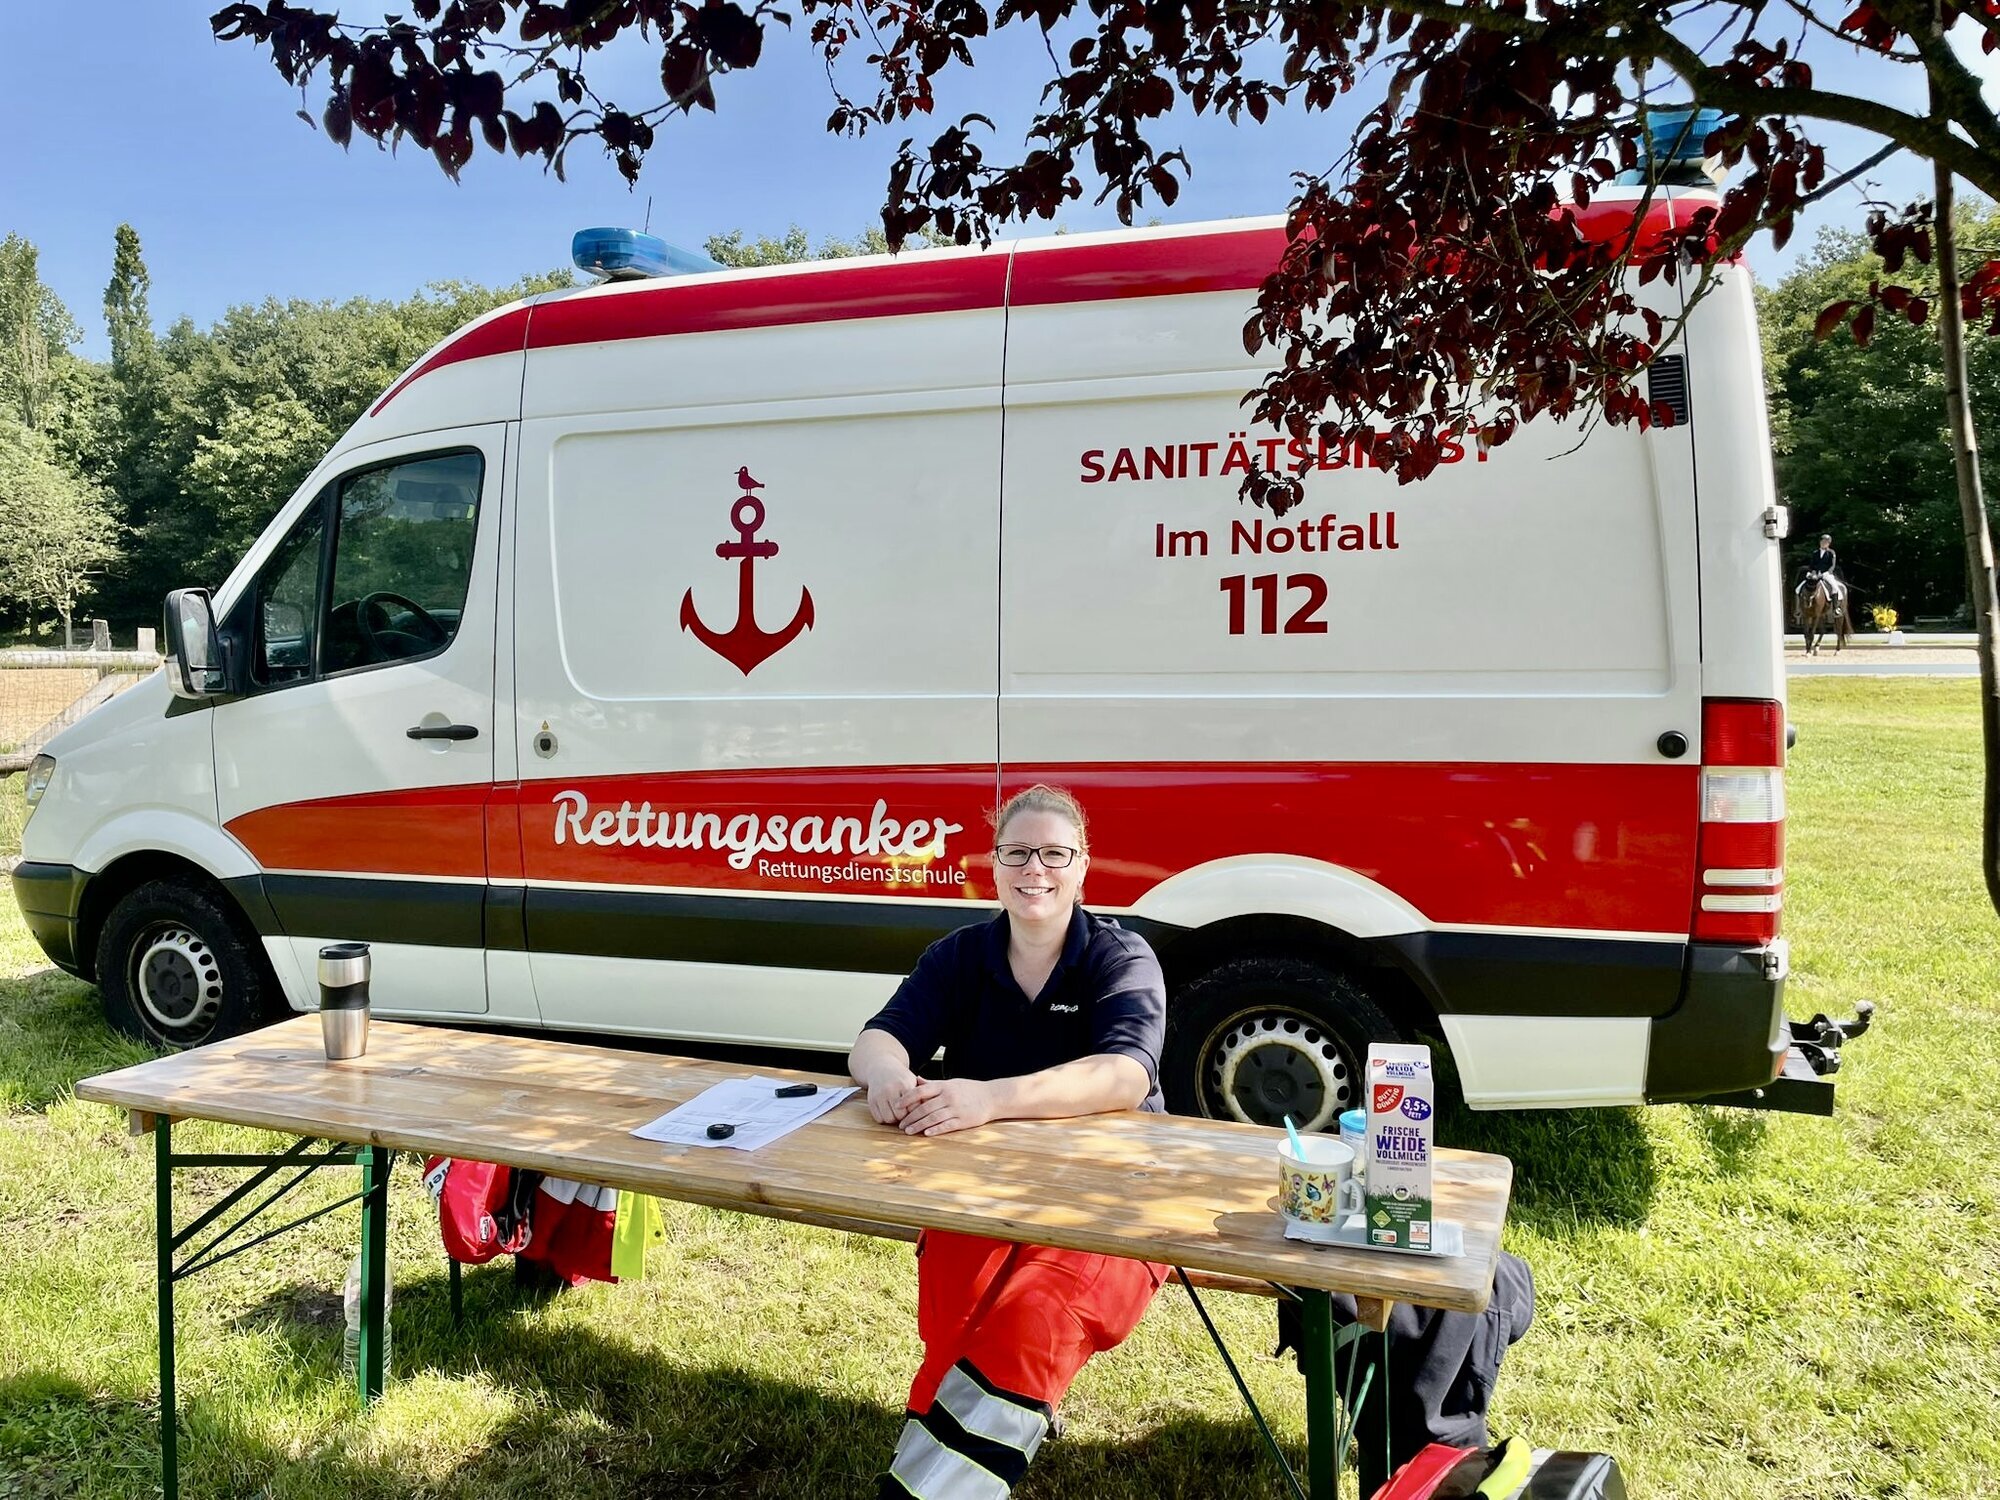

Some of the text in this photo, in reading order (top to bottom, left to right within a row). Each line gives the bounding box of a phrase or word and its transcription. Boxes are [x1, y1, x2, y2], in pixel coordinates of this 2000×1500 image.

[1080, 426, 1492, 483] SANITÄTSDIS
[1155, 512, 1399, 558] Im Notfall
[1219, 573, 1328, 636] 112
[552, 790, 964, 870] Rettungsanker
[758, 859, 967, 886] Rettungsdienstschule
[1376, 1135, 1426, 1152] WEIDE
[1383, 1126, 1420, 1137] FRISCHE
[1376, 1150, 1426, 1161] VOLLMILCH
